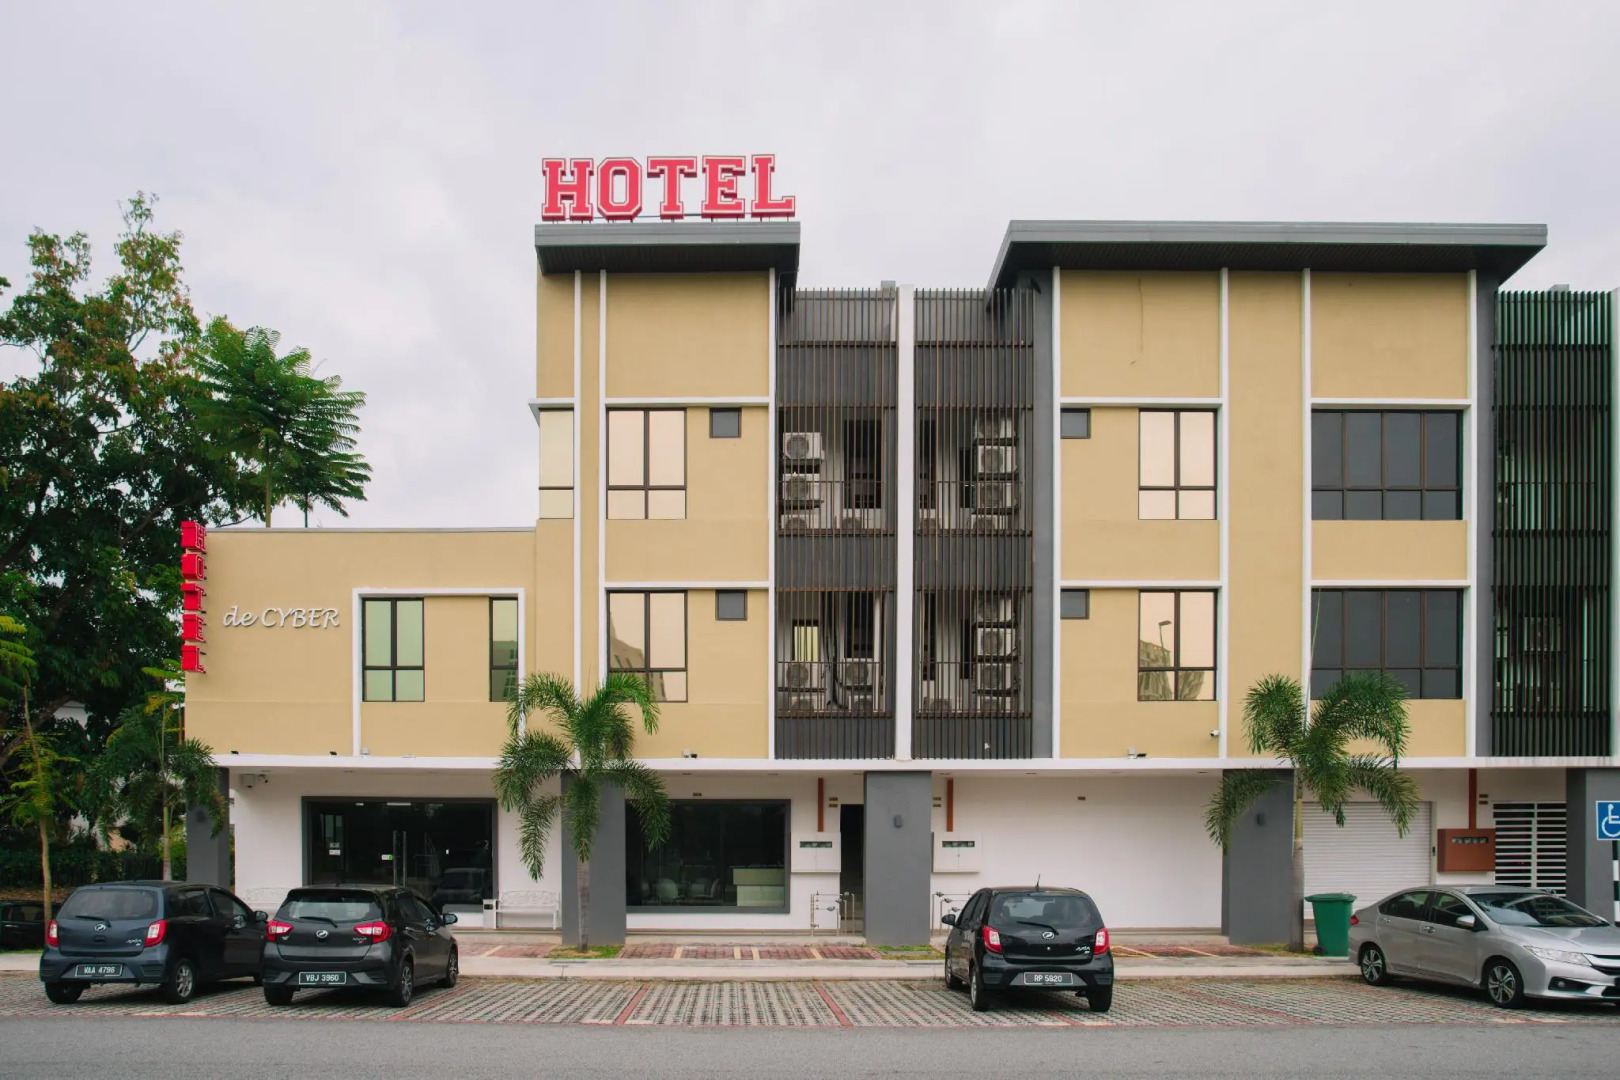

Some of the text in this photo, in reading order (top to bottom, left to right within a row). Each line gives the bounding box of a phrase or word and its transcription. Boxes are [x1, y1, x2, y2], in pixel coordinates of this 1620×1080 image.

[541, 154, 796, 222] HOTEL
[181, 521, 207, 674] HOTEL
[223, 605, 340, 629] de CYBER
[305, 974, 319, 982] VBJ
[1034, 974, 1043, 982] RP
